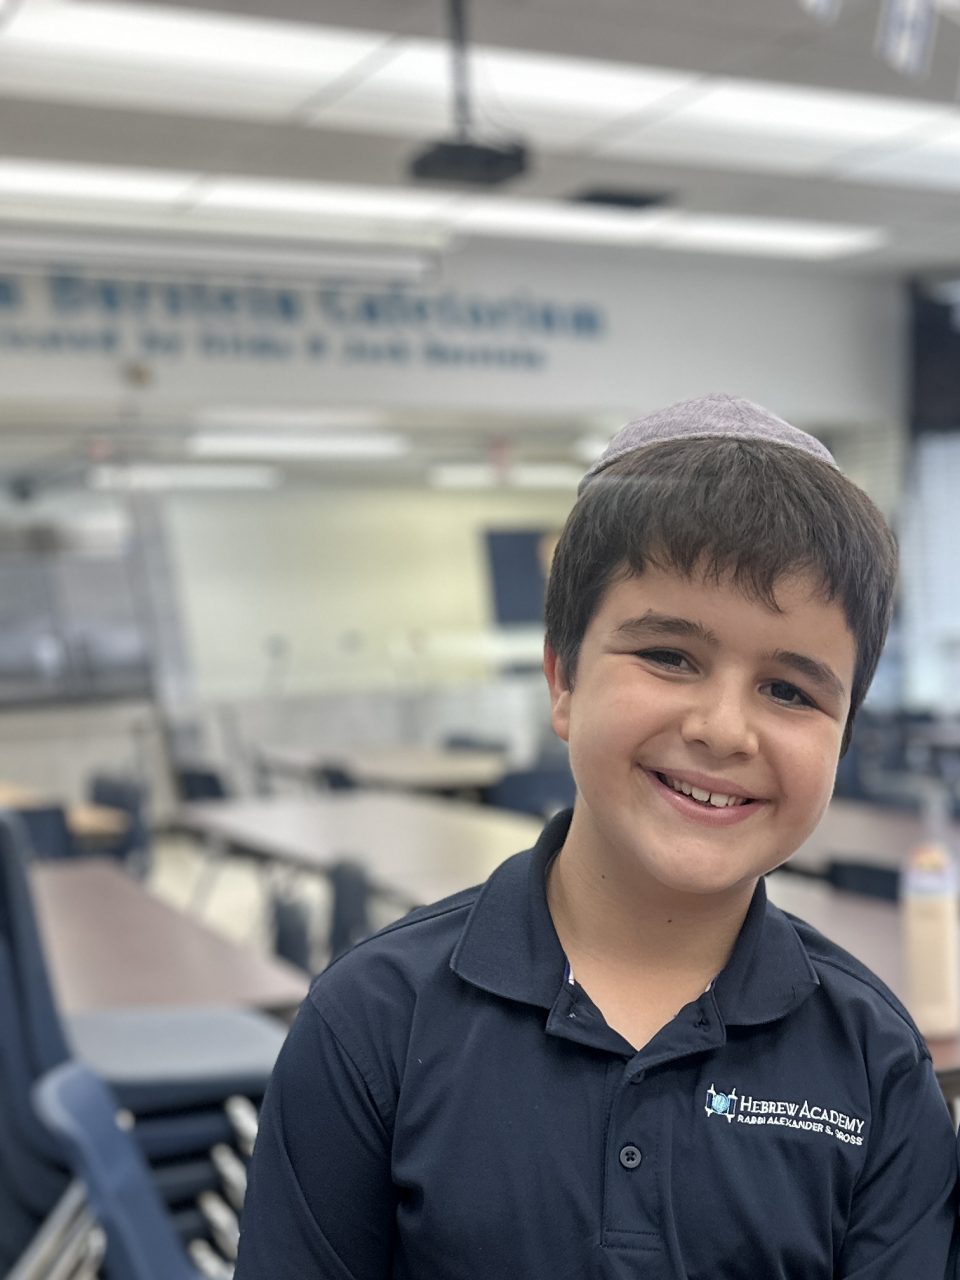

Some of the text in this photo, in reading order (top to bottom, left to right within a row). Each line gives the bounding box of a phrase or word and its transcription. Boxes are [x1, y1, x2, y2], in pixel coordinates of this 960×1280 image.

[737, 1114, 766, 1125] RABBI
[766, 1116, 824, 1133] ALEXANDER
[740, 1095, 865, 1134] HEBREW ACADEMY
